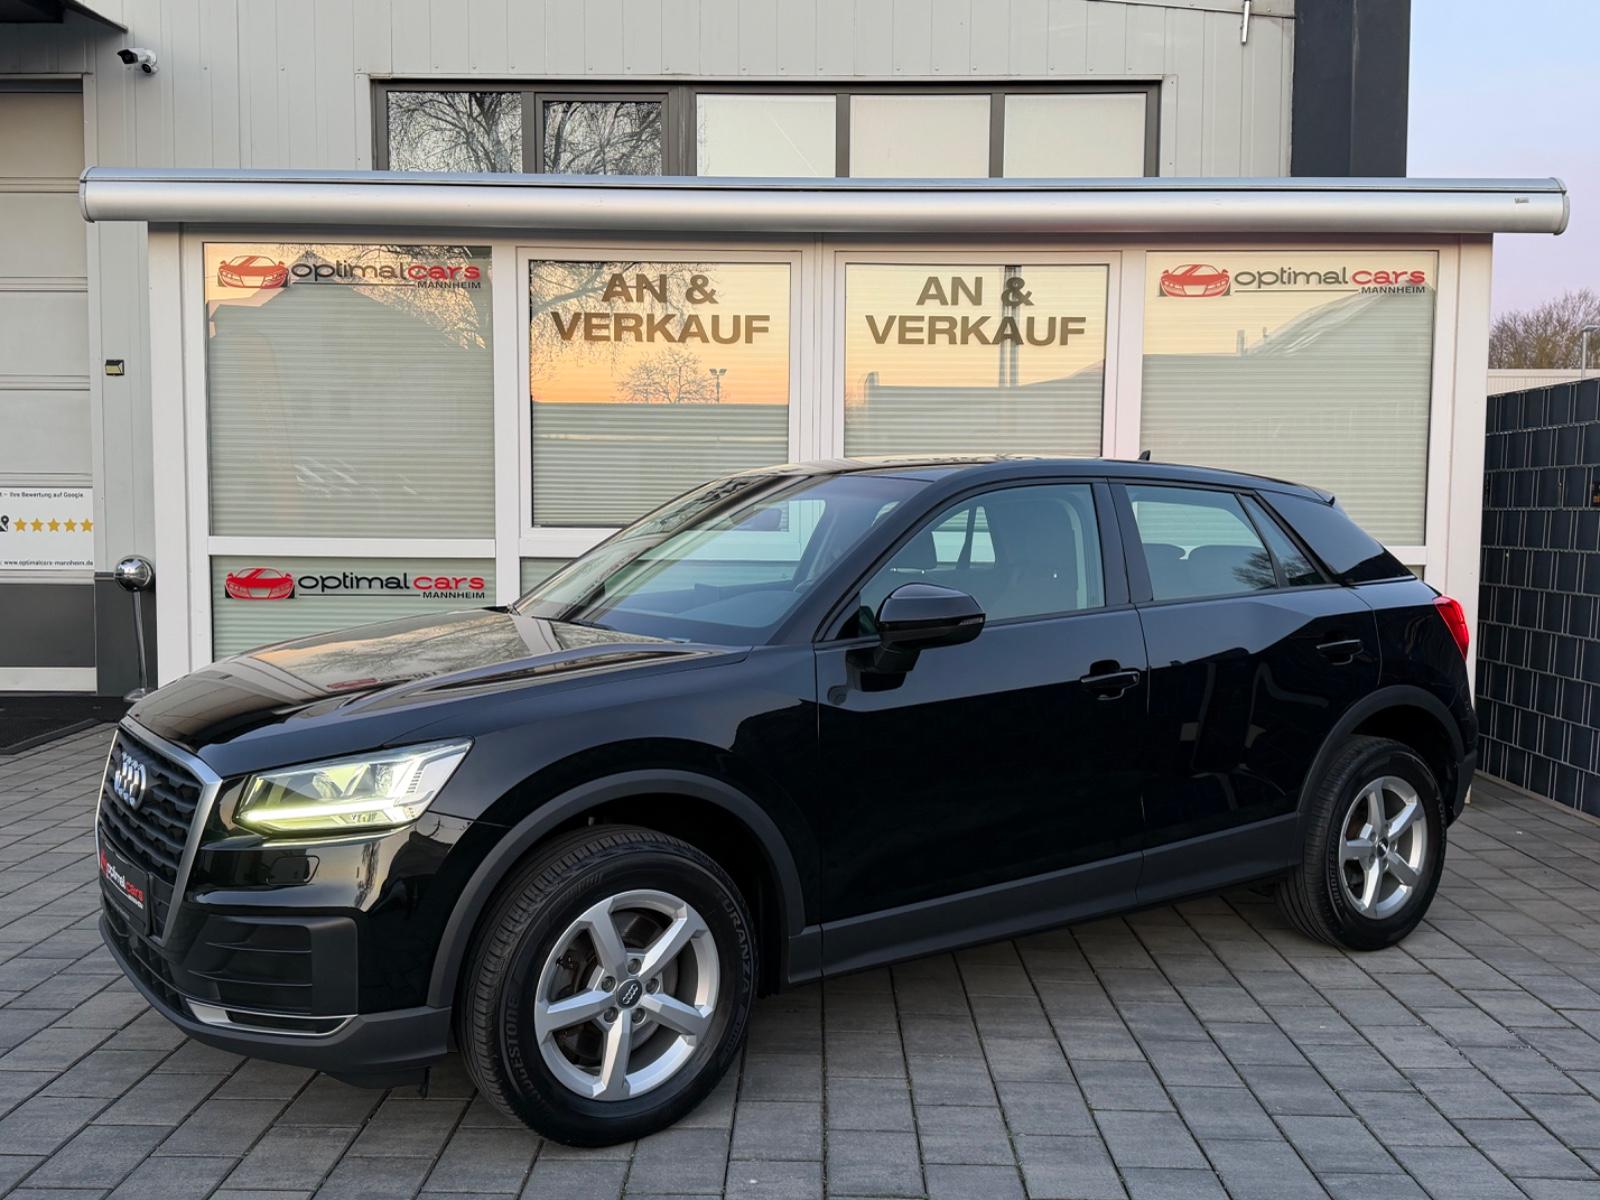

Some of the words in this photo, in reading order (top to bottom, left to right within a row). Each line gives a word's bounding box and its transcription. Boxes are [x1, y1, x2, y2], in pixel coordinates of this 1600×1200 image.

[416, 281, 482, 290] MANNHEIM
[601, 273, 668, 304] AN
[685, 274, 719, 305] &
[916, 276, 983, 306] AN
[1001, 277, 1035, 307] &
[1361, 286, 1426, 294] MANNHEIM
[550, 311, 771, 345] VERKAUF
[865, 315, 1087, 347] VERKAUF
[21, 491, 52, 499] Bewertung
[63, 491, 84, 499] Google
[422, 592, 485, 600] MANNHEIM
